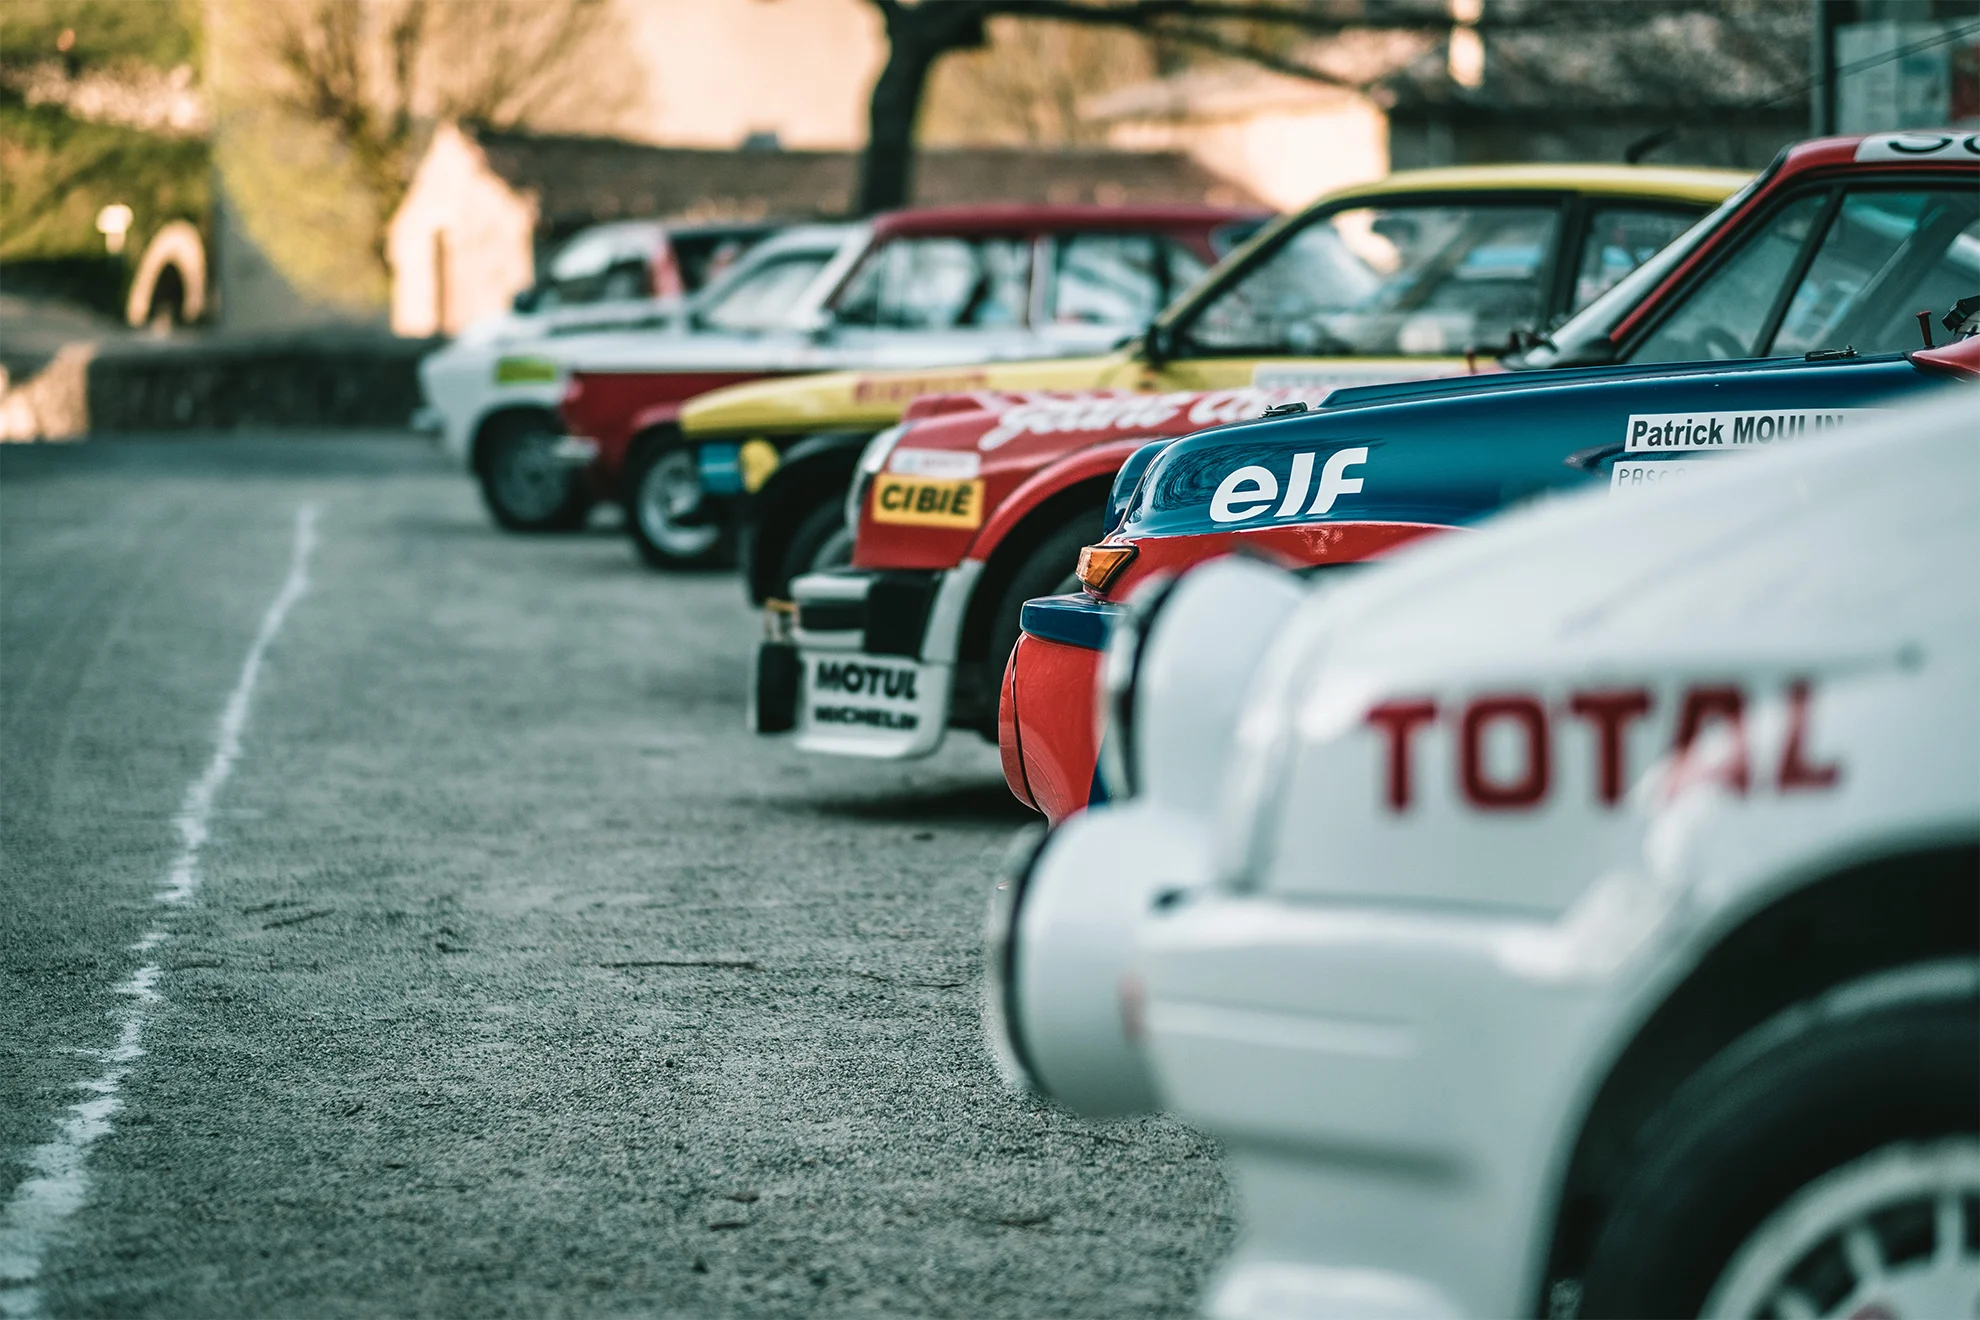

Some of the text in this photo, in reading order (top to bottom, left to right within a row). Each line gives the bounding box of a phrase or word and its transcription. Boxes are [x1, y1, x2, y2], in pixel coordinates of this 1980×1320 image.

[1631, 414, 1843, 447] Patrick MOULIN
[1209, 446, 1369, 523] elf
[815, 661, 917, 700] MOTUL
[1364, 676, 1842, 812] TOTAL
